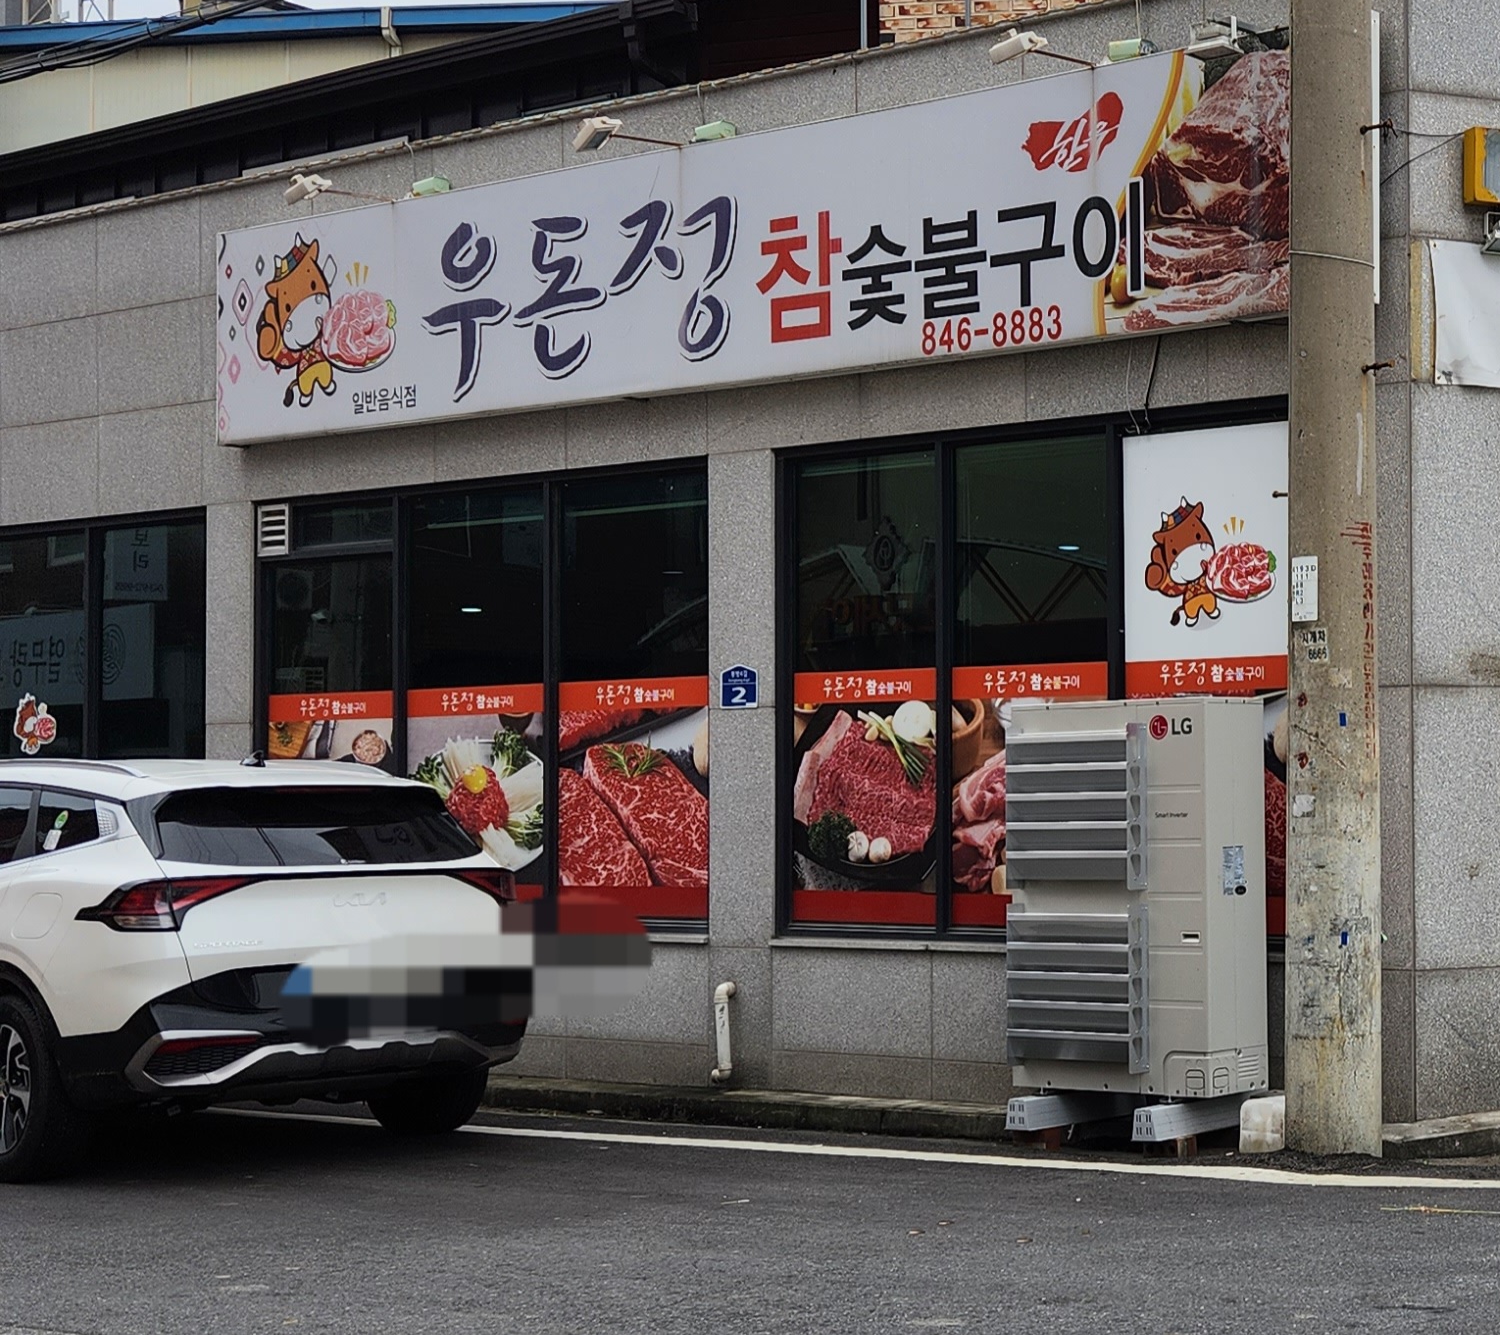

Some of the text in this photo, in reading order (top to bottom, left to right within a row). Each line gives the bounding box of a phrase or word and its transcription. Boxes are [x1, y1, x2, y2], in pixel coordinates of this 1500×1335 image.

[1046, 104, 1120, 169] 한우
[423, 177, 1146, 403] 우돈정 참숯불구이
[921, 304, 1063, 355] 846-8883
[352, 385, 417, 414] 일반음식점
[983, 670, 1080, 694] 우돈정 참숯불구이
[1159, 662, 1266, 686] 우돈정 참숯불구이
[595, 683, 675, 706] 우돈정 참숯불구이
[731, 686, 747, 703] 2
[823, 676, 912, 699] 우돈정 참숯불구이
[299, 697, 367, 717] 우돈정 참숯불구이
[441, 691, 514, 712] 우돈정 참숯불구이
[1155, 811, 1188, 819] Smart Inverter
